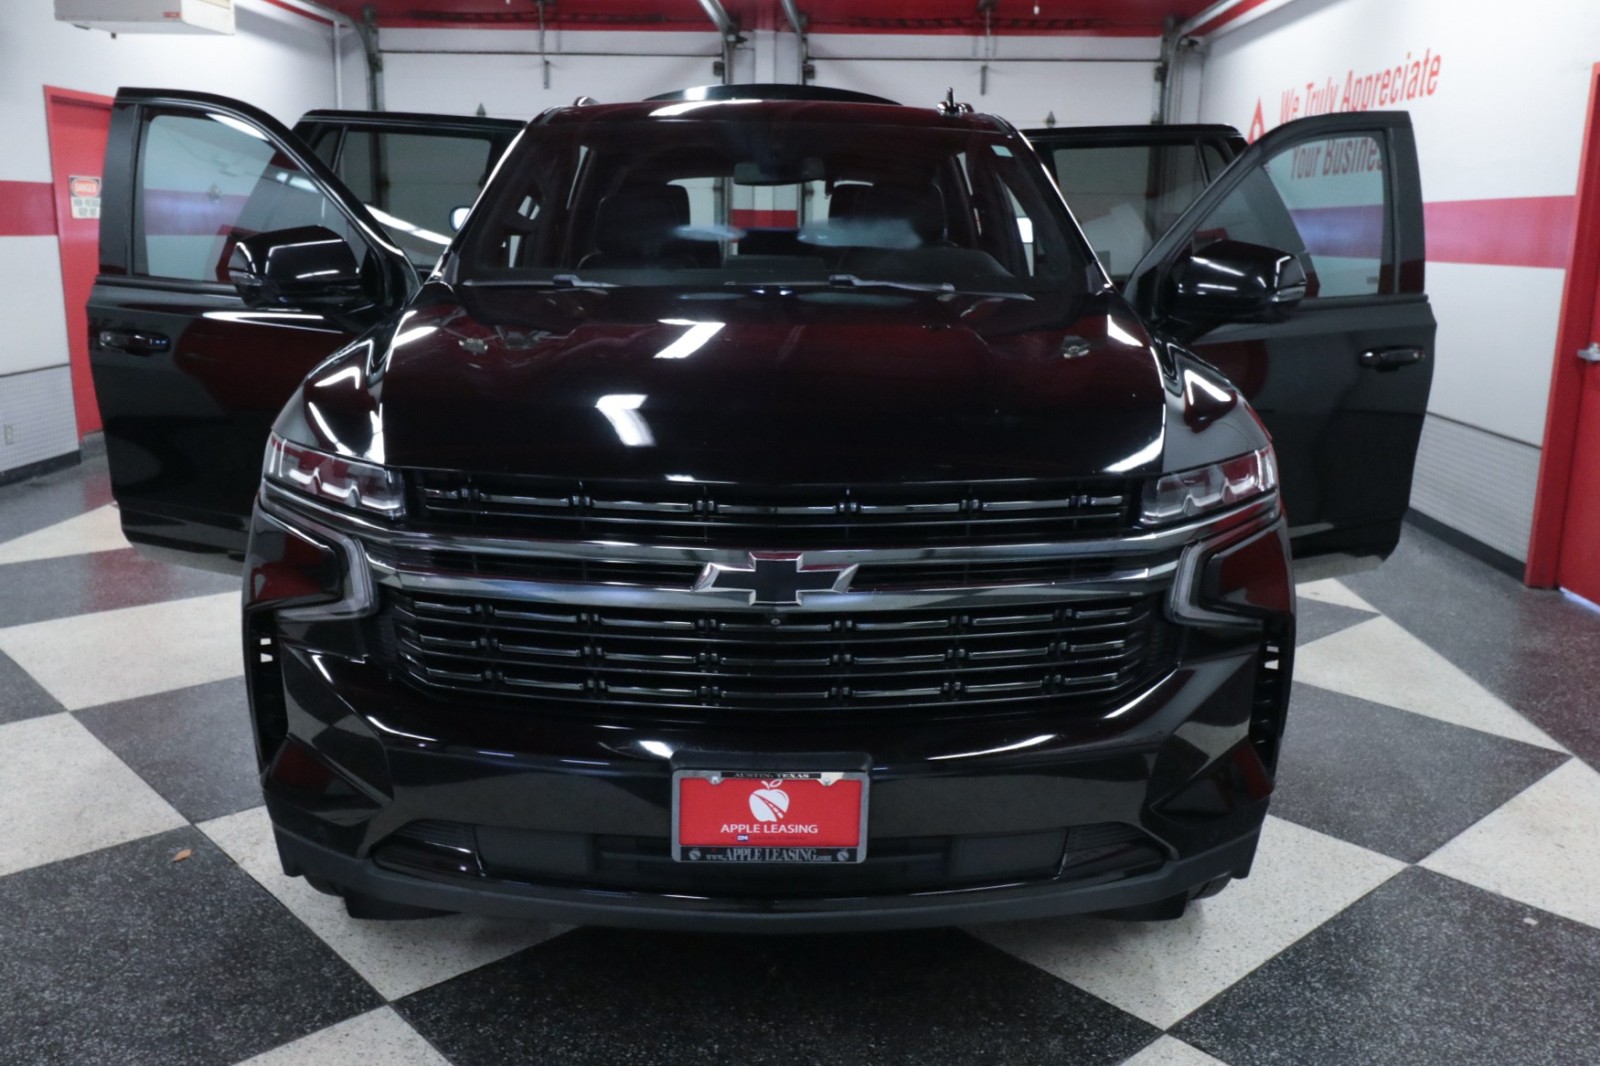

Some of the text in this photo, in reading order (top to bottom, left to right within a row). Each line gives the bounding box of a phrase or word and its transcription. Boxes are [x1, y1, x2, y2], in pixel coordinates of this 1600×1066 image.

[1340, 48, 1441, 112] Appreciate
[720, 824, 819, 834] APPLE LEASING
